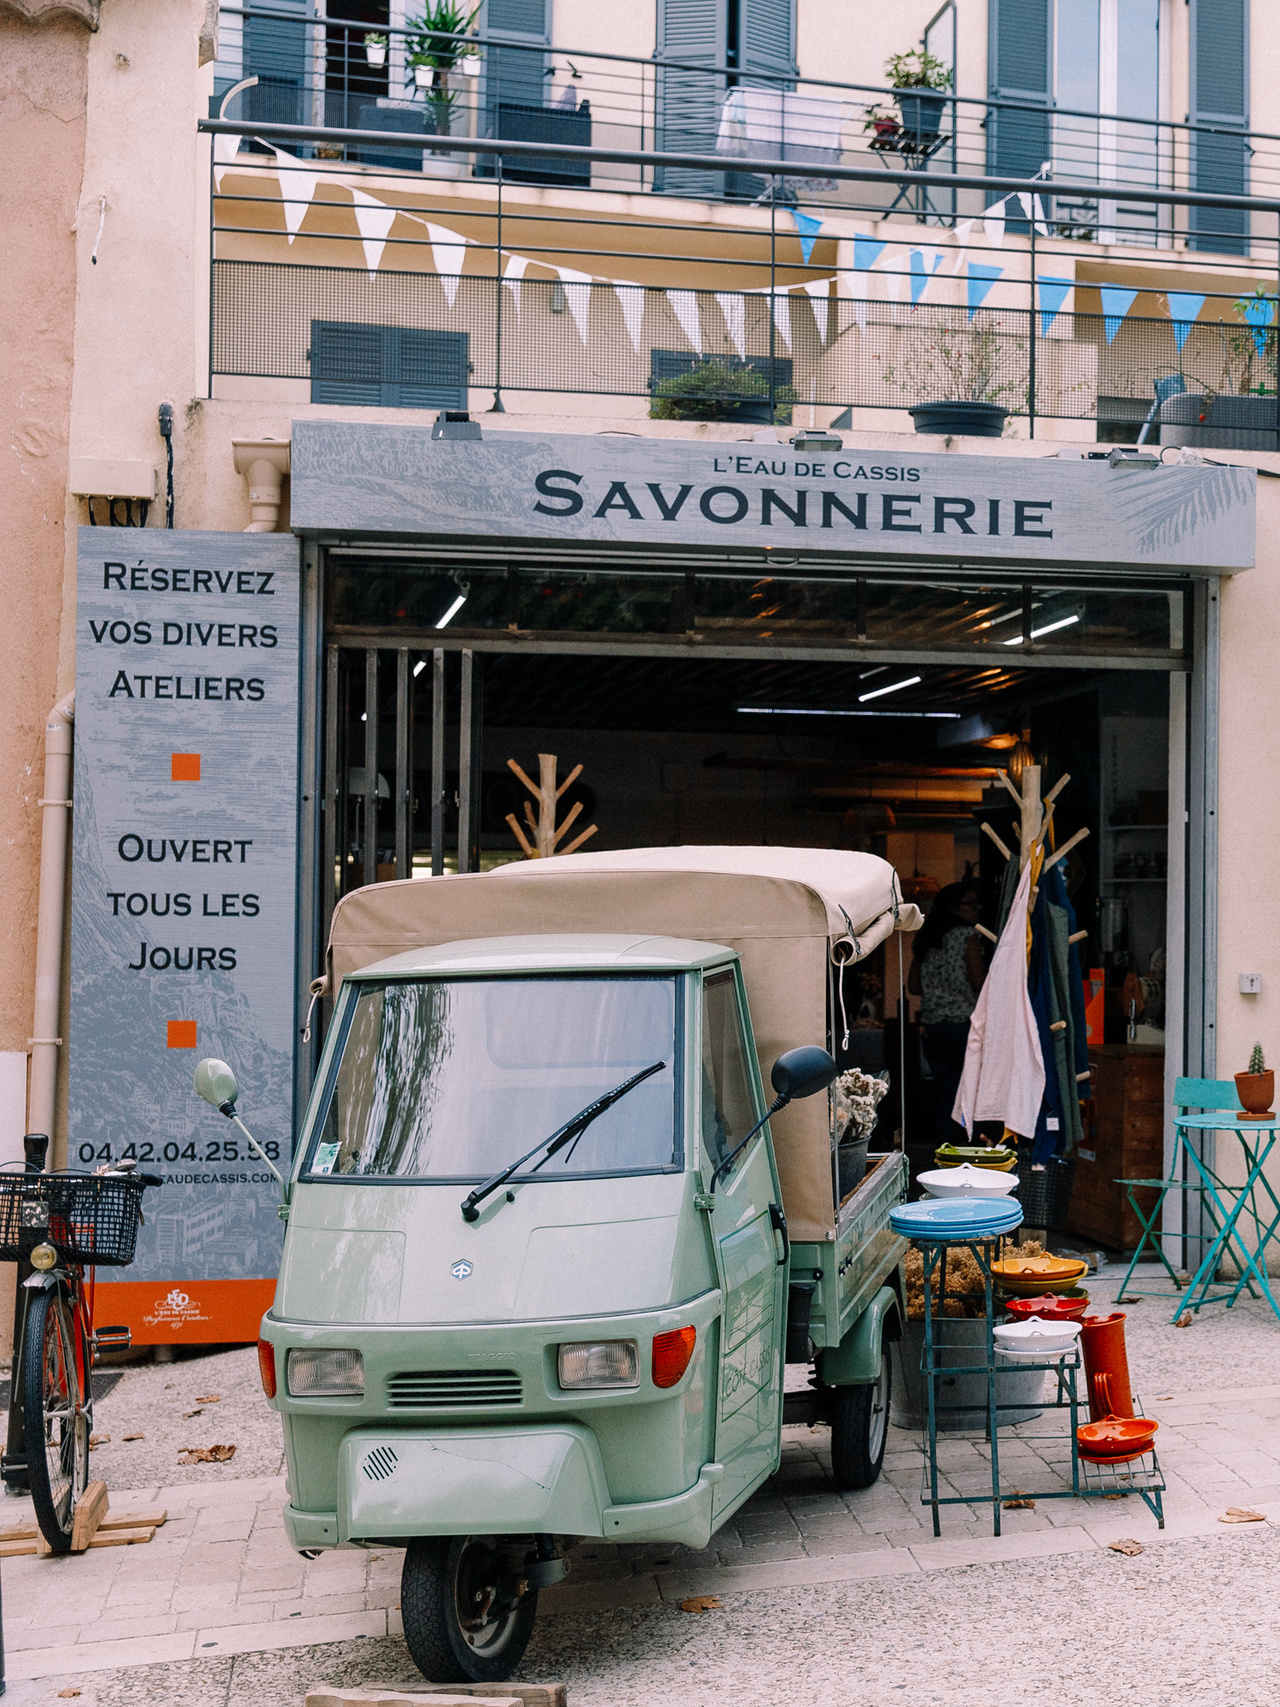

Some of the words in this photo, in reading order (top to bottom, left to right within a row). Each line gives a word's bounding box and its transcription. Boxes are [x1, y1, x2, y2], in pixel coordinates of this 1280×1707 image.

[793, 462, 827, 477] DE
[831, 461, 921, 483] CASSIS
[533, 469, 1054, 538] SAVONNERIE
[103, 560, 275, 595] RÉSERVEZ
[88, 618, 153, 645] VOS
[162, 622, 279, 649] DIVERS
[108, 670, 266, 702] ATELIERS
[118, 834, 253, 863] OUVERT
[106, 892, 193, 917] TOUS
[201, 893, 261, 917] LES
[127, 942, 238, 971] JOURS
